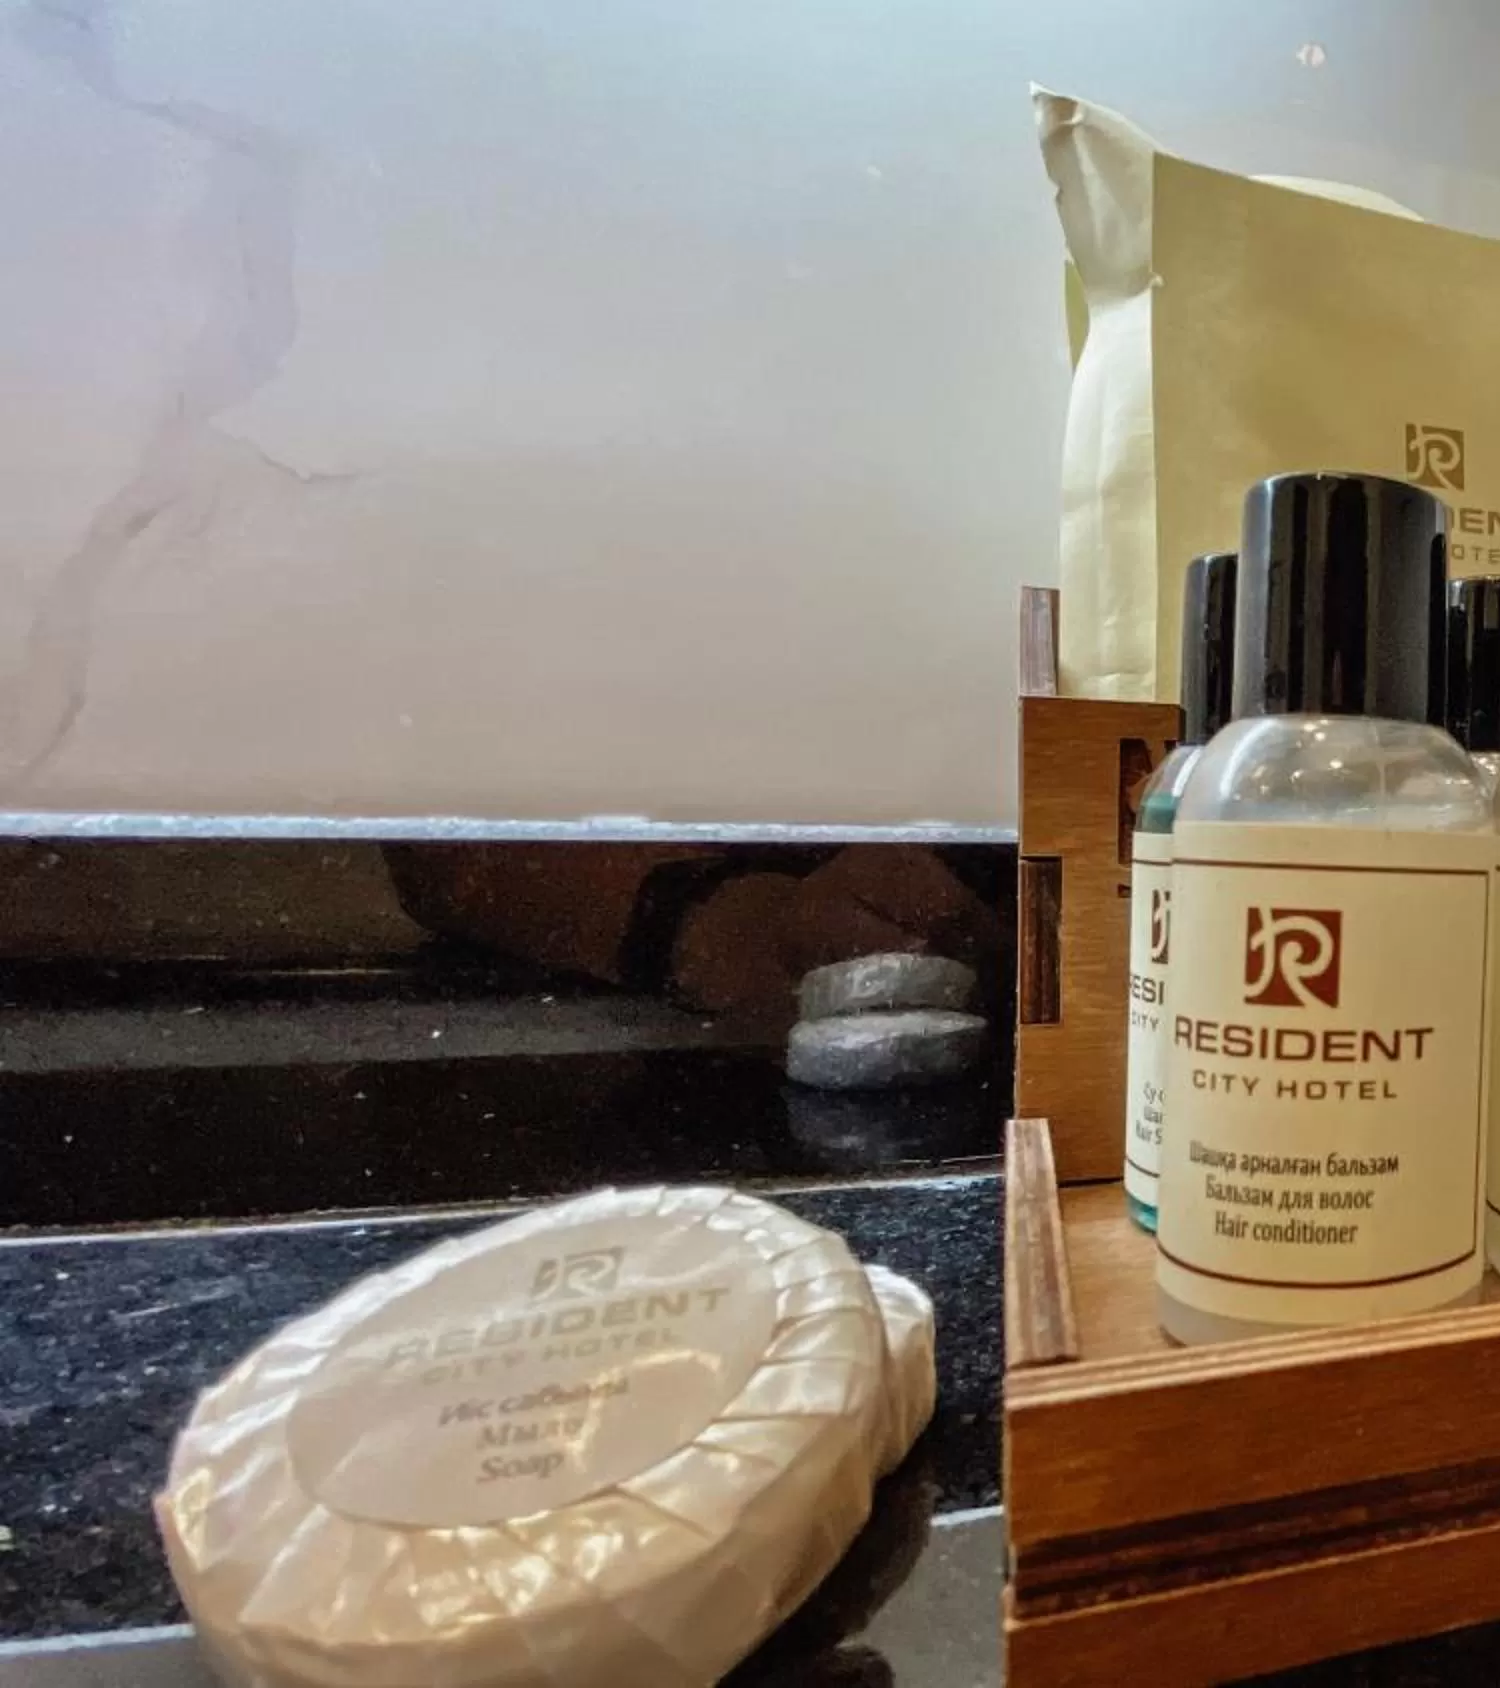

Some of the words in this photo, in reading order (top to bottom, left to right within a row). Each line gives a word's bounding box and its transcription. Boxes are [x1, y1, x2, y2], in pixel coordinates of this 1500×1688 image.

[1175, 1015, 1434, 1063] RESIDENT
[1193, 1069, 1260, 1096] CITY
[1276, 1079, 1399, 1100] HOTEL
[1326, 1152, 1399, 1177] бальзам
[1206, 1173, 1273, 1208] Бальзам
[1278, 1189, 1315, 1213] для
[1319, 1189, 1375, 1210] волос
[1215, 1210, 1249, 1239] Hair
[1252, 1218, 1359, 1245] conditioner
[383, 1286, 731, 1371] RESIDENT
[476, 1449, 565, 1483] Soap
